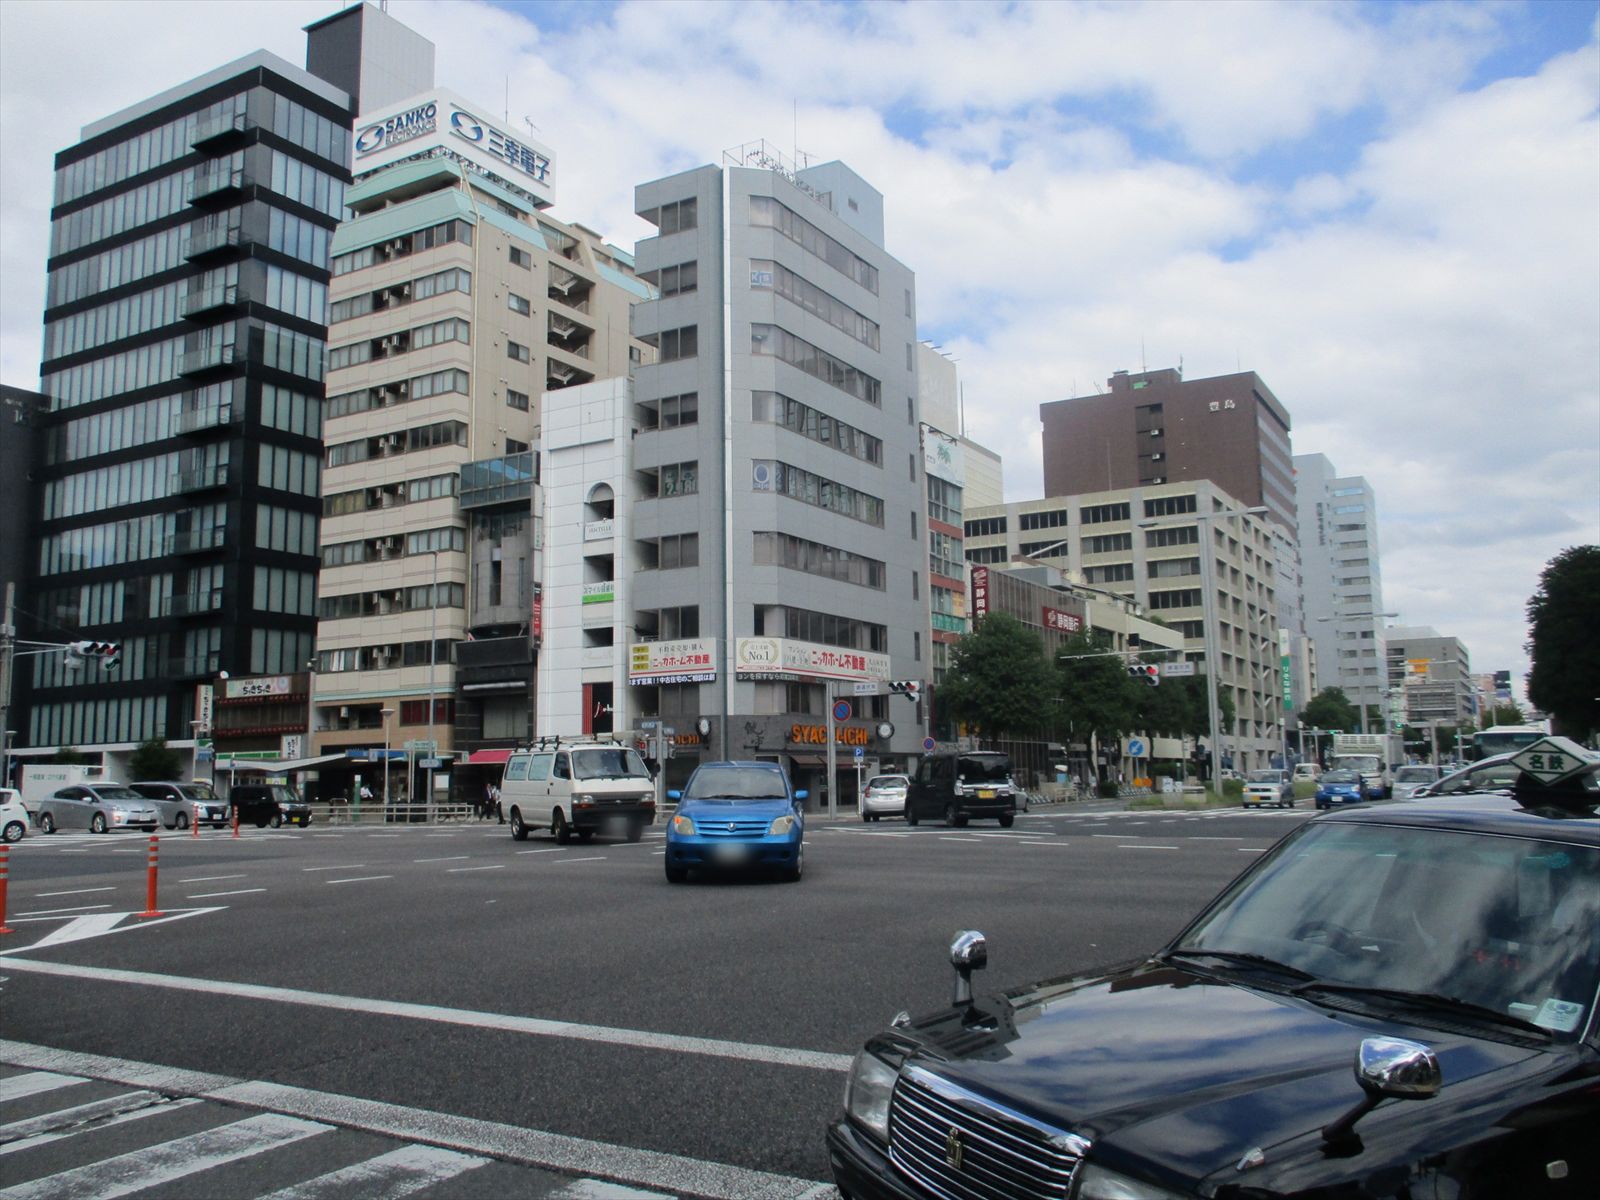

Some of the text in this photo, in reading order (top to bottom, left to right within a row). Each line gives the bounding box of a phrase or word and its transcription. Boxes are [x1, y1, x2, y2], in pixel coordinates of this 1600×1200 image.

[386, 103, 437, 134] SANKO
[386, 121, 437, 145] ELECTRONICS
[489, 128, 550, 180] 三幸電子
[653, 654, 710, 667] ニッカホーム不動産
[749, 651, 769, 661] No.1
[812, 651, 866, 671] ニッカホーム不動産
[1529, 754, 1564, 770] 名鉄
